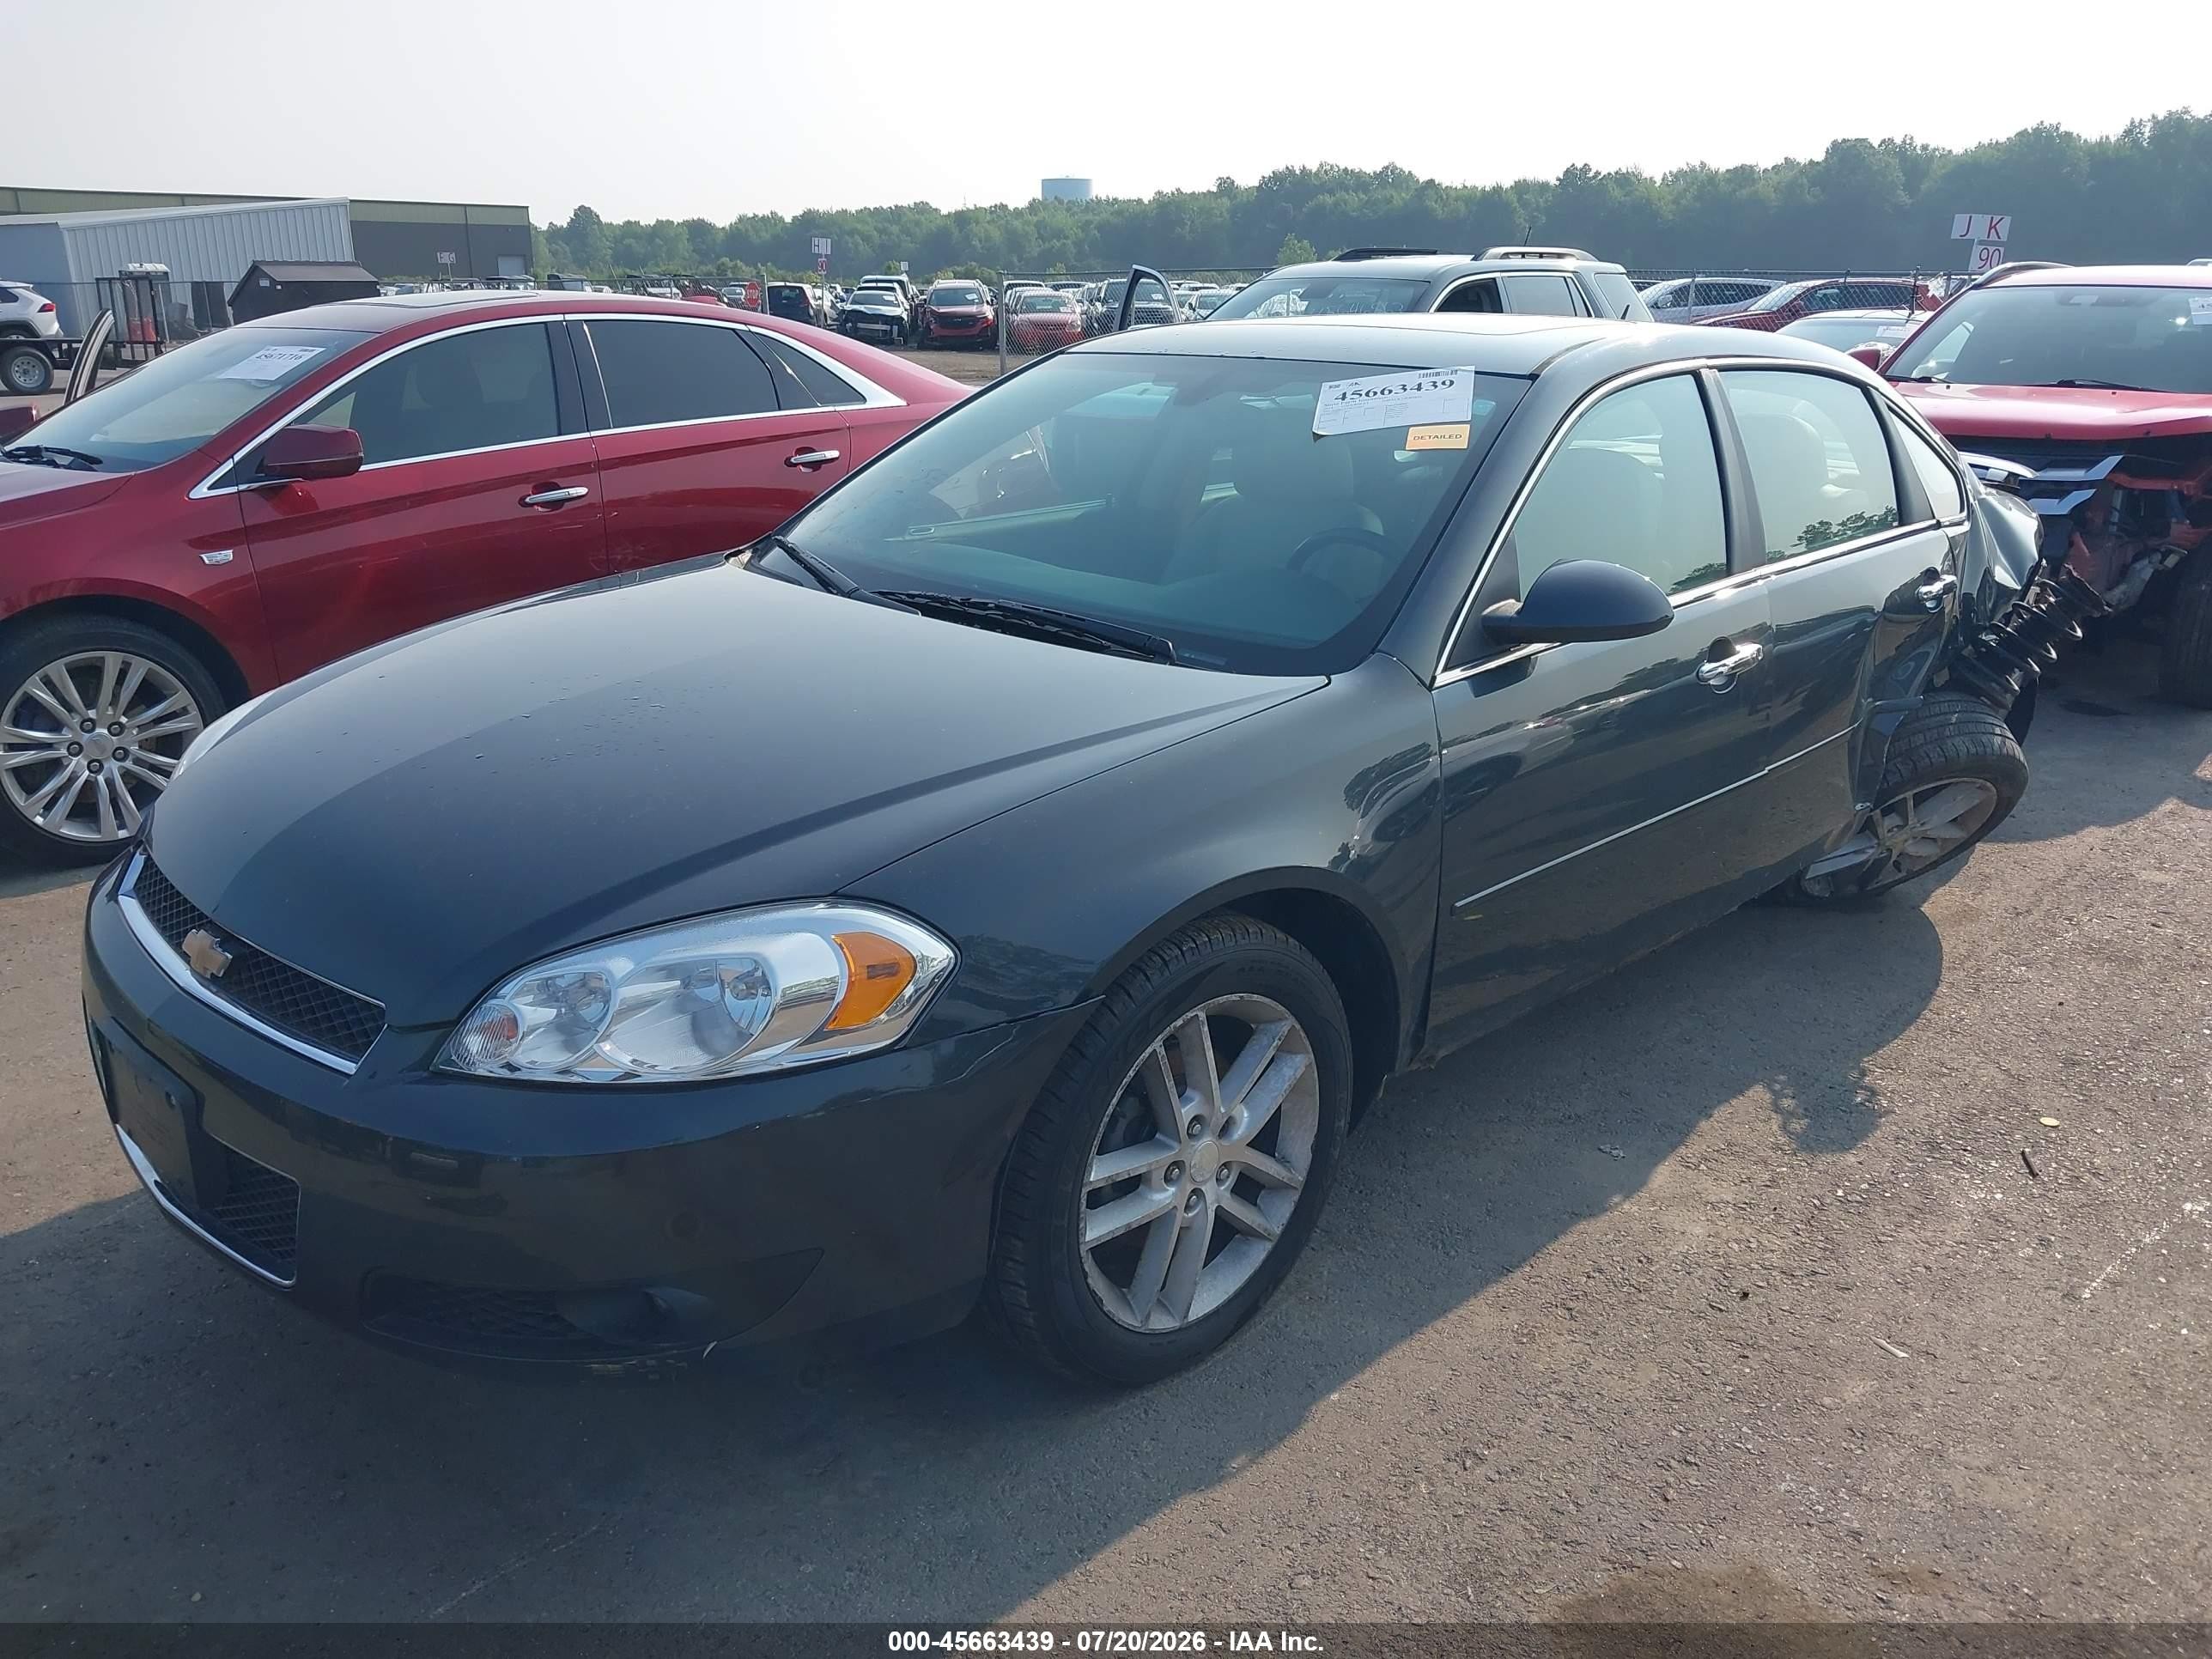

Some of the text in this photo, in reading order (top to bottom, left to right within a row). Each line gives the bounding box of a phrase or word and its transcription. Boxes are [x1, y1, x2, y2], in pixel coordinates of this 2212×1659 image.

[1959, 215, 2005, 240] J K
[813, 238, 820, 252] H
[1978, 246, 2002, 270] 90
[746, 289, 759, 300] STOP
[1334, 379, 1455, 402] 45663439
[1413, 433, 1462, 441] DETAILED
